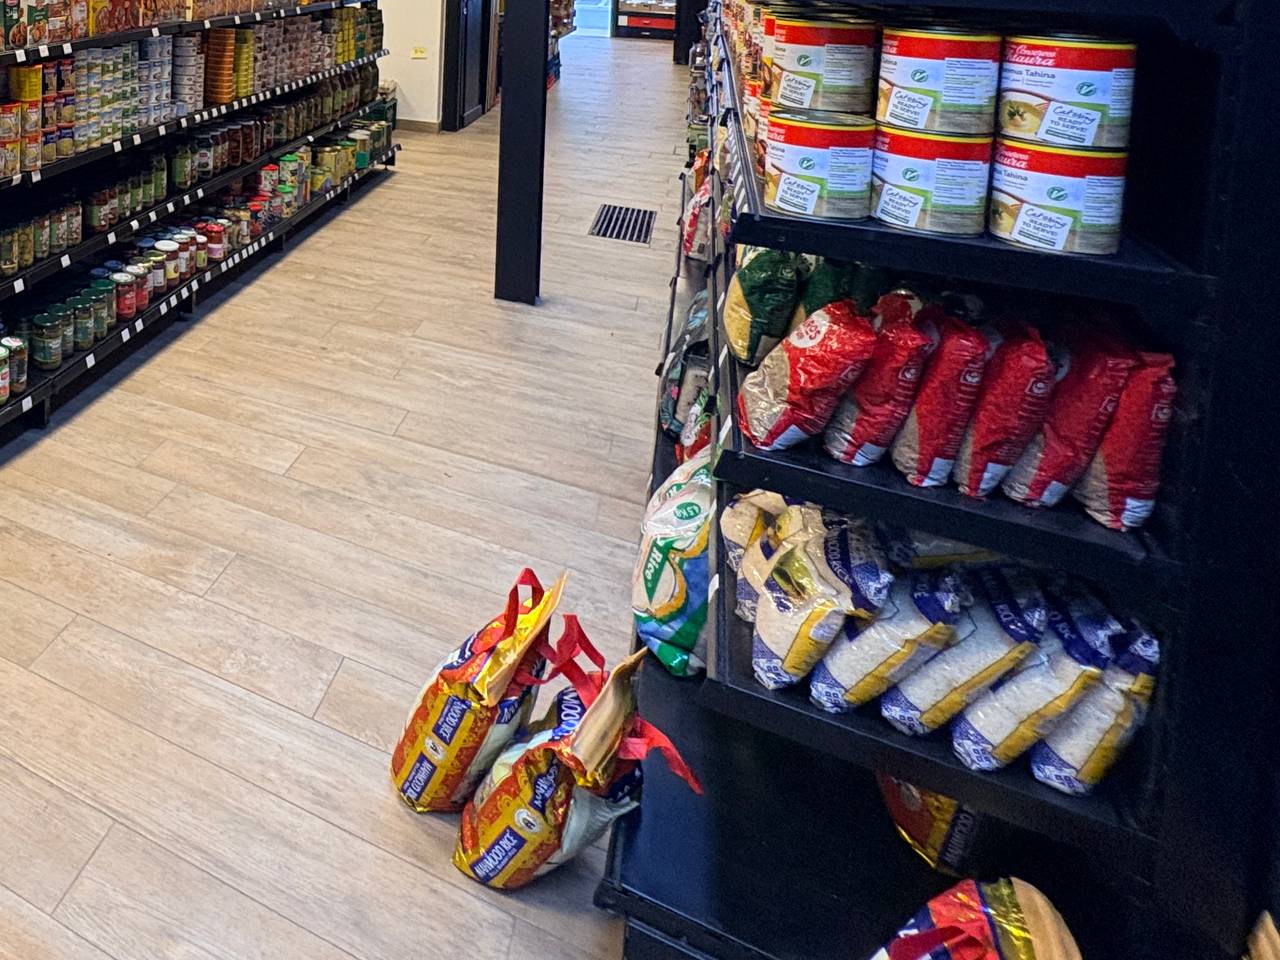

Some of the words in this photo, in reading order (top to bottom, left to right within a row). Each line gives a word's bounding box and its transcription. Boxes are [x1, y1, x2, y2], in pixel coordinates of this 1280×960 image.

[1025, 68, 1056, 80] Tahina
[1053, 104, 1097, 125] Catering
[1003, 169, 1029, 182] Tahina
[1024, 207, 1068, 230] Catering
[643, 547, 665, 581] Rice
